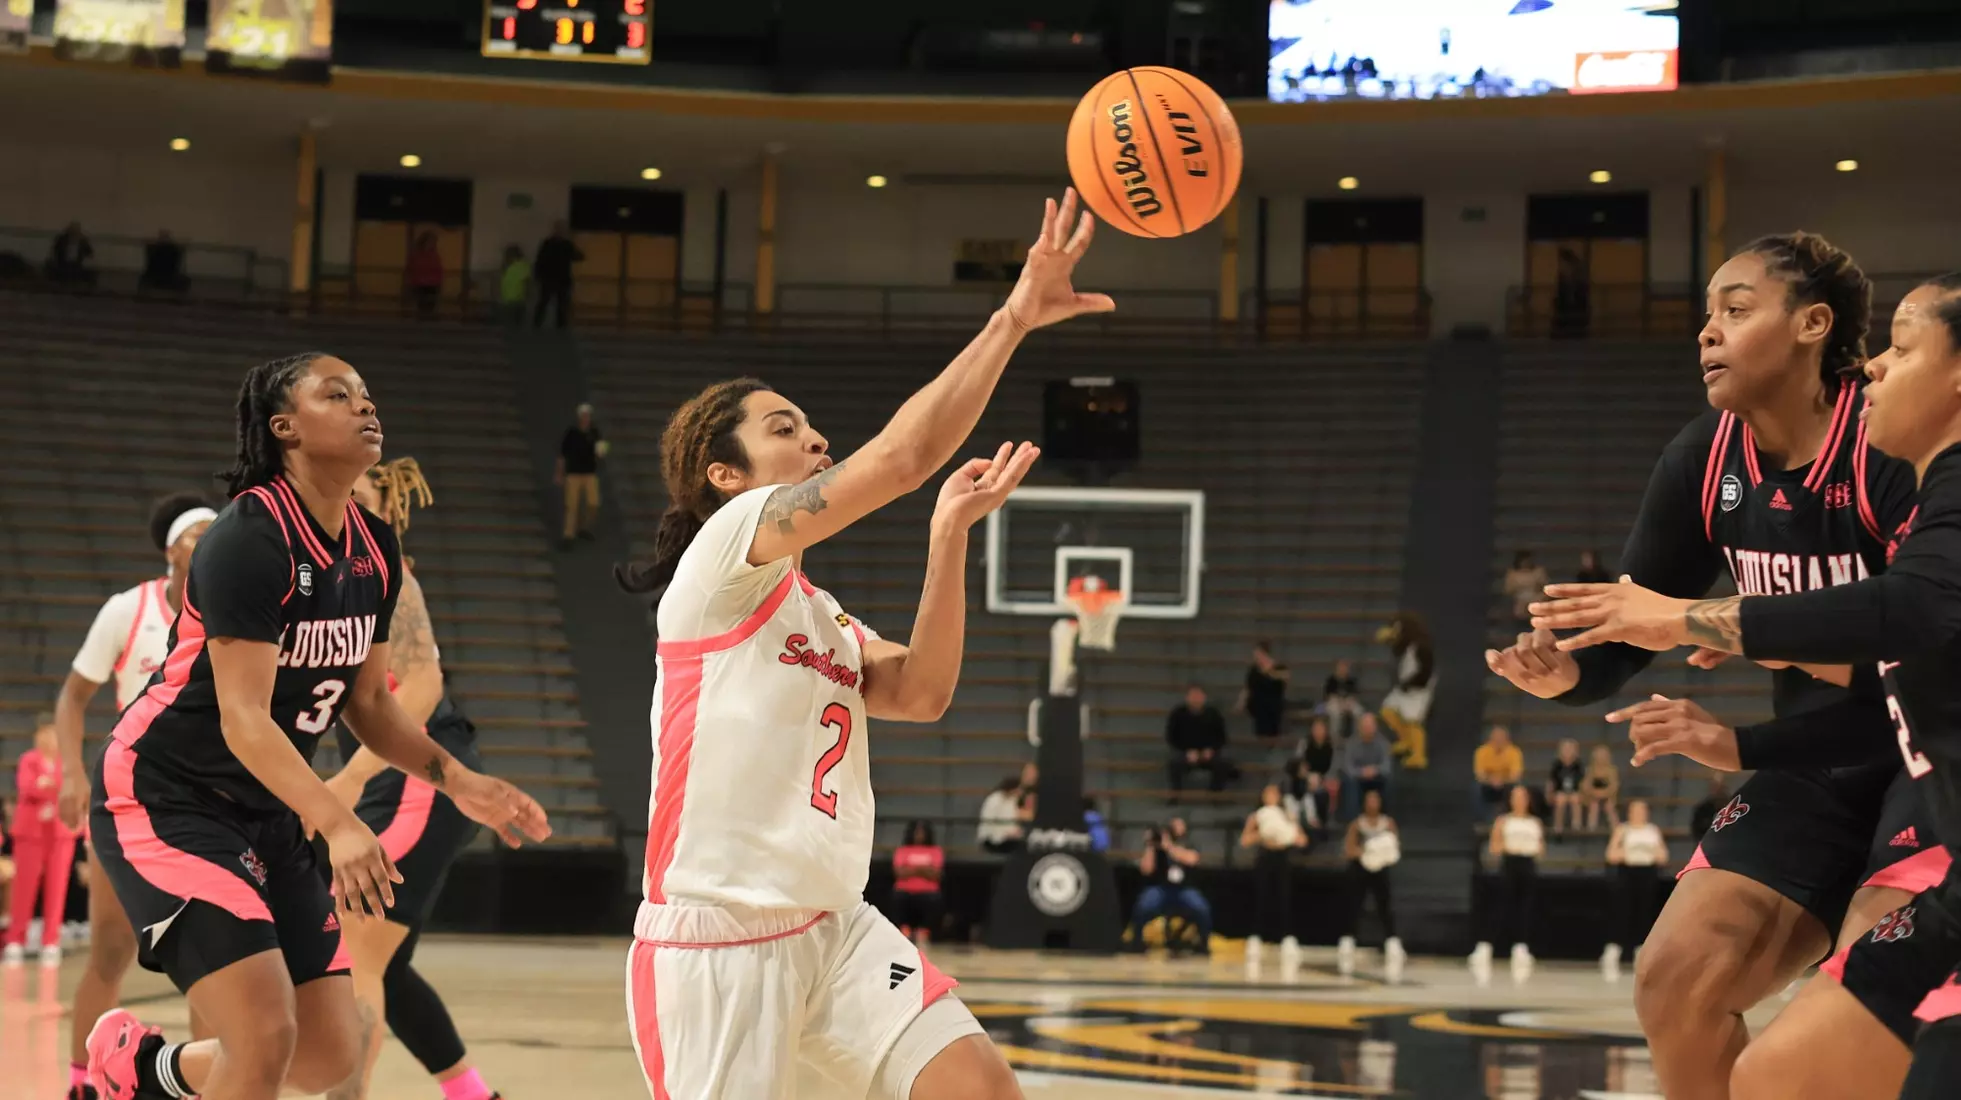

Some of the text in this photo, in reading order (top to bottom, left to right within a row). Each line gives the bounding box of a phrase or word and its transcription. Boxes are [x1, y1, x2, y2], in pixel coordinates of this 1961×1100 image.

[1109, 102, 1163, 220] Wilson
[778, 633, 859, 690] Southern
[295, 678, 347, 736] 3
[811, 701, 852, 821] 2
